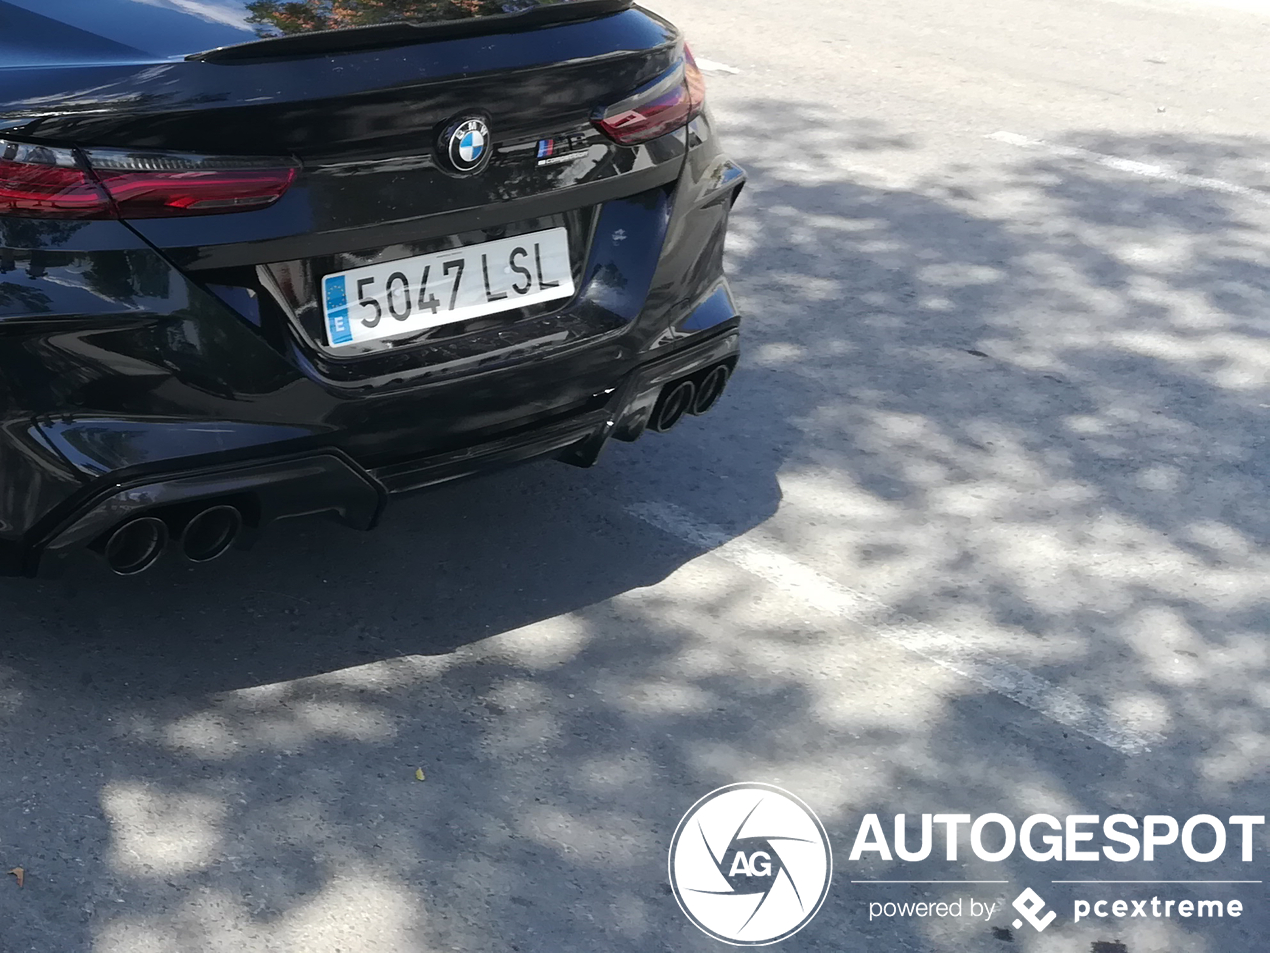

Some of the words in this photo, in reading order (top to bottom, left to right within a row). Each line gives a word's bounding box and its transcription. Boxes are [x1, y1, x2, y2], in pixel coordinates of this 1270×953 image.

[455, 121, 489, 140] BMW
[334, 316, 345, 332] E
[357, 258, 465, 328] 5047
[482, 243, 560, 303] LSL
